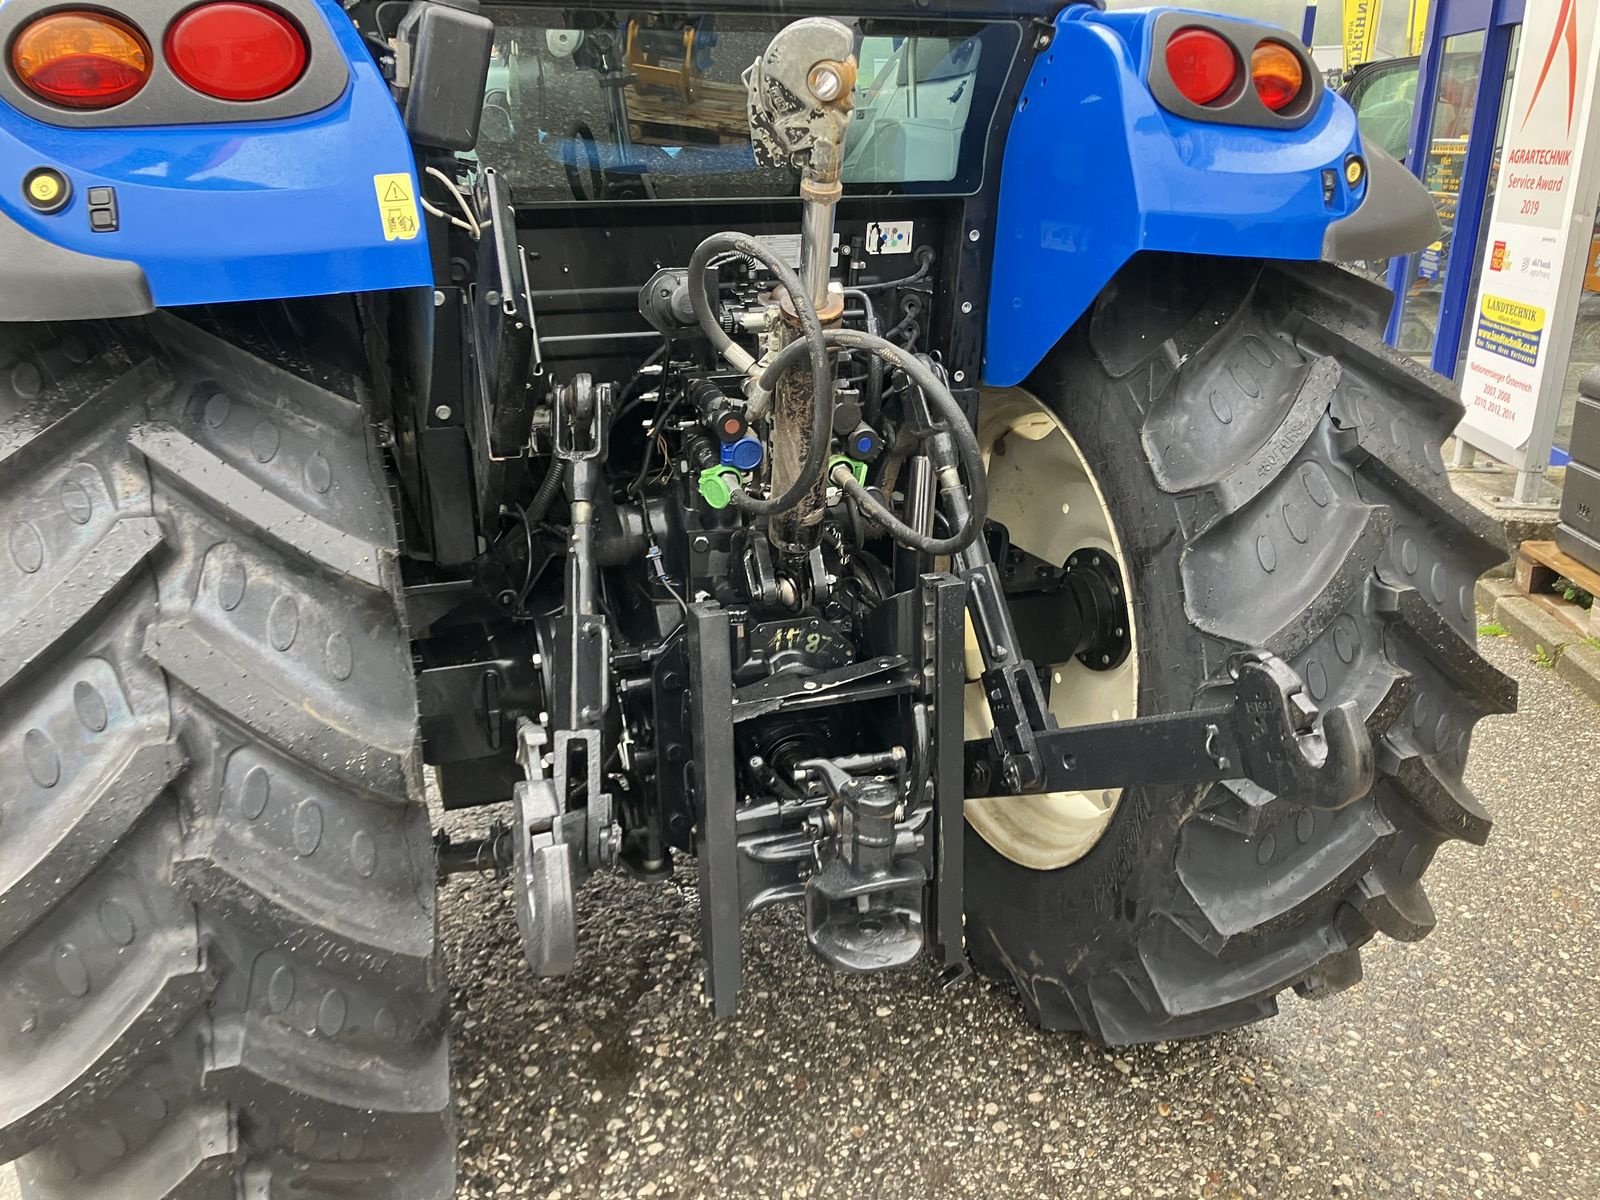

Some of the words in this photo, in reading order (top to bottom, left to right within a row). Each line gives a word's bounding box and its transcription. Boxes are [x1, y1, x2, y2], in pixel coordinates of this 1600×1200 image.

[1508, 149, 1572, 166] AGRARTECHNIK
[1507, 173, 1536, 190] Service
[1535, 175, 1564, 192] Award
[1520, 200, 1540, 216] 2019
[1487, 298, 1537, 322] LANDTECHNIK
